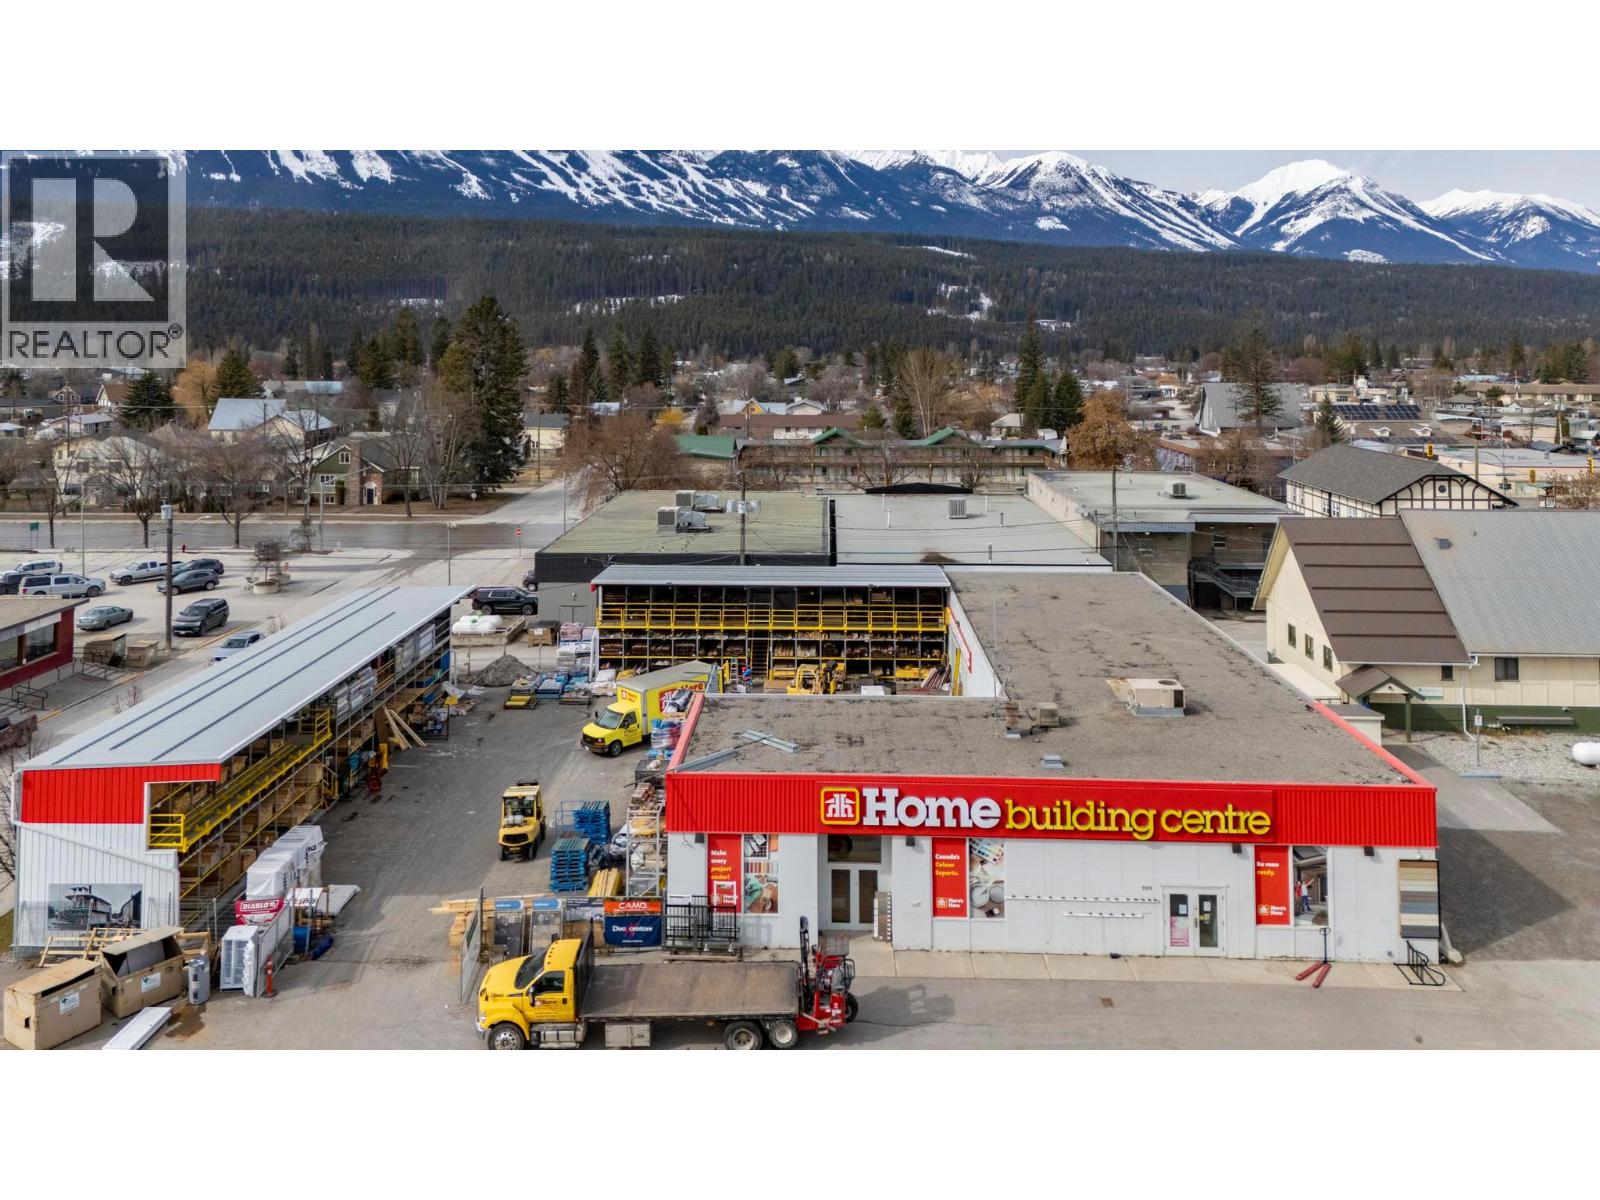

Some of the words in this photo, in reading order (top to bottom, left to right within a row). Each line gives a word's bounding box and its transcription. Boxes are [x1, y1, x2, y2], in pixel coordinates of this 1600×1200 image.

[862, 787, 1002, 829] Home
[1005, 799, 1157, 841] building
[1160, 804, 1272, 836] centre
[242, 901, 270, 911] DIABLO
